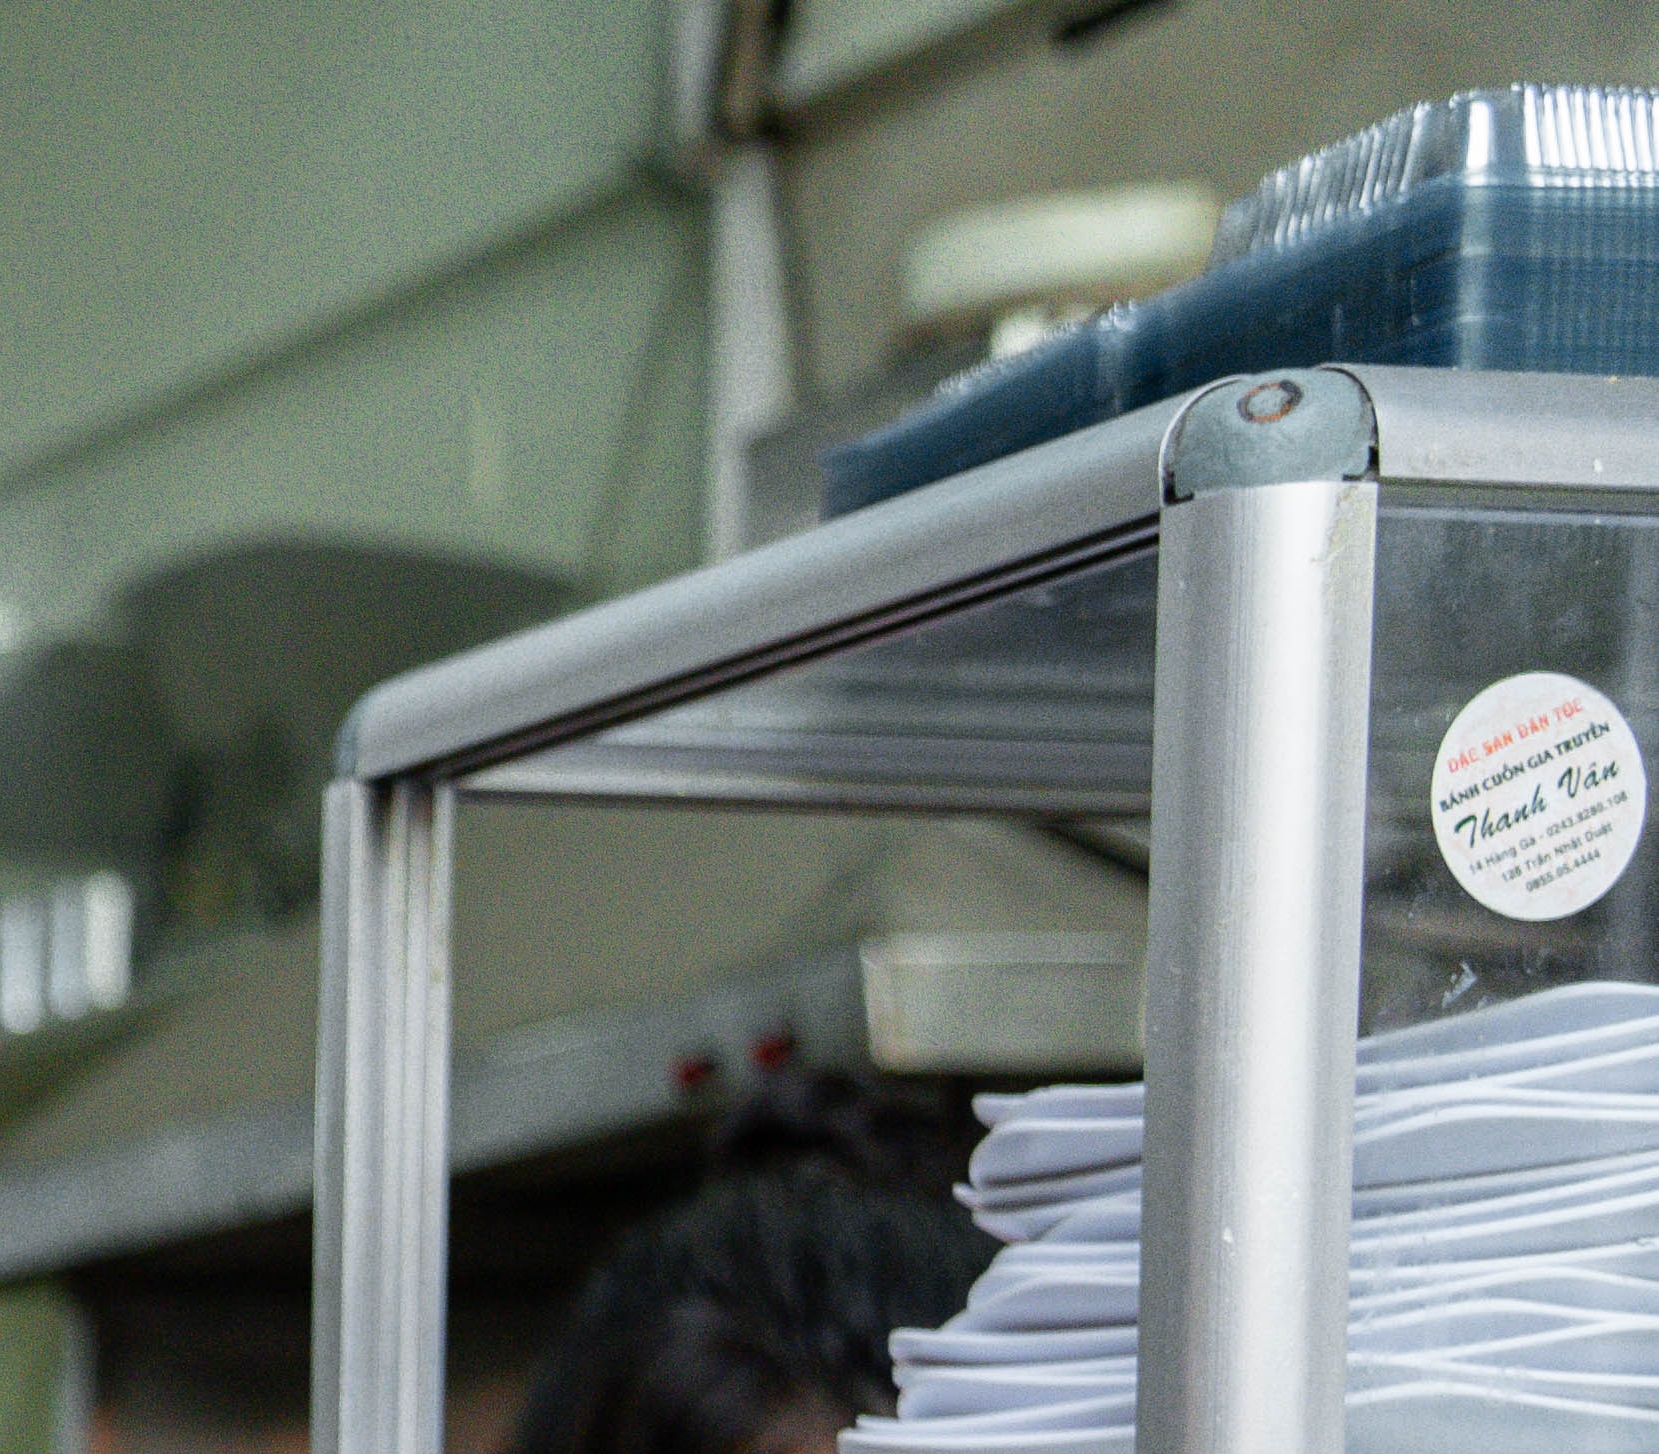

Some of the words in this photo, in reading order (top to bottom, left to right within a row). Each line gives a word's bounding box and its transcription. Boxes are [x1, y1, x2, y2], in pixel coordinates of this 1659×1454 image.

[1439, 783, 1480, 812] BÁNH
[1482, 761, 1525, 791] CUỐN
[1527, 749, 1554, 769] GIA
[1454, 783, 1548, 849] Thanh
[1557, 760, 1620, 798] Vân
